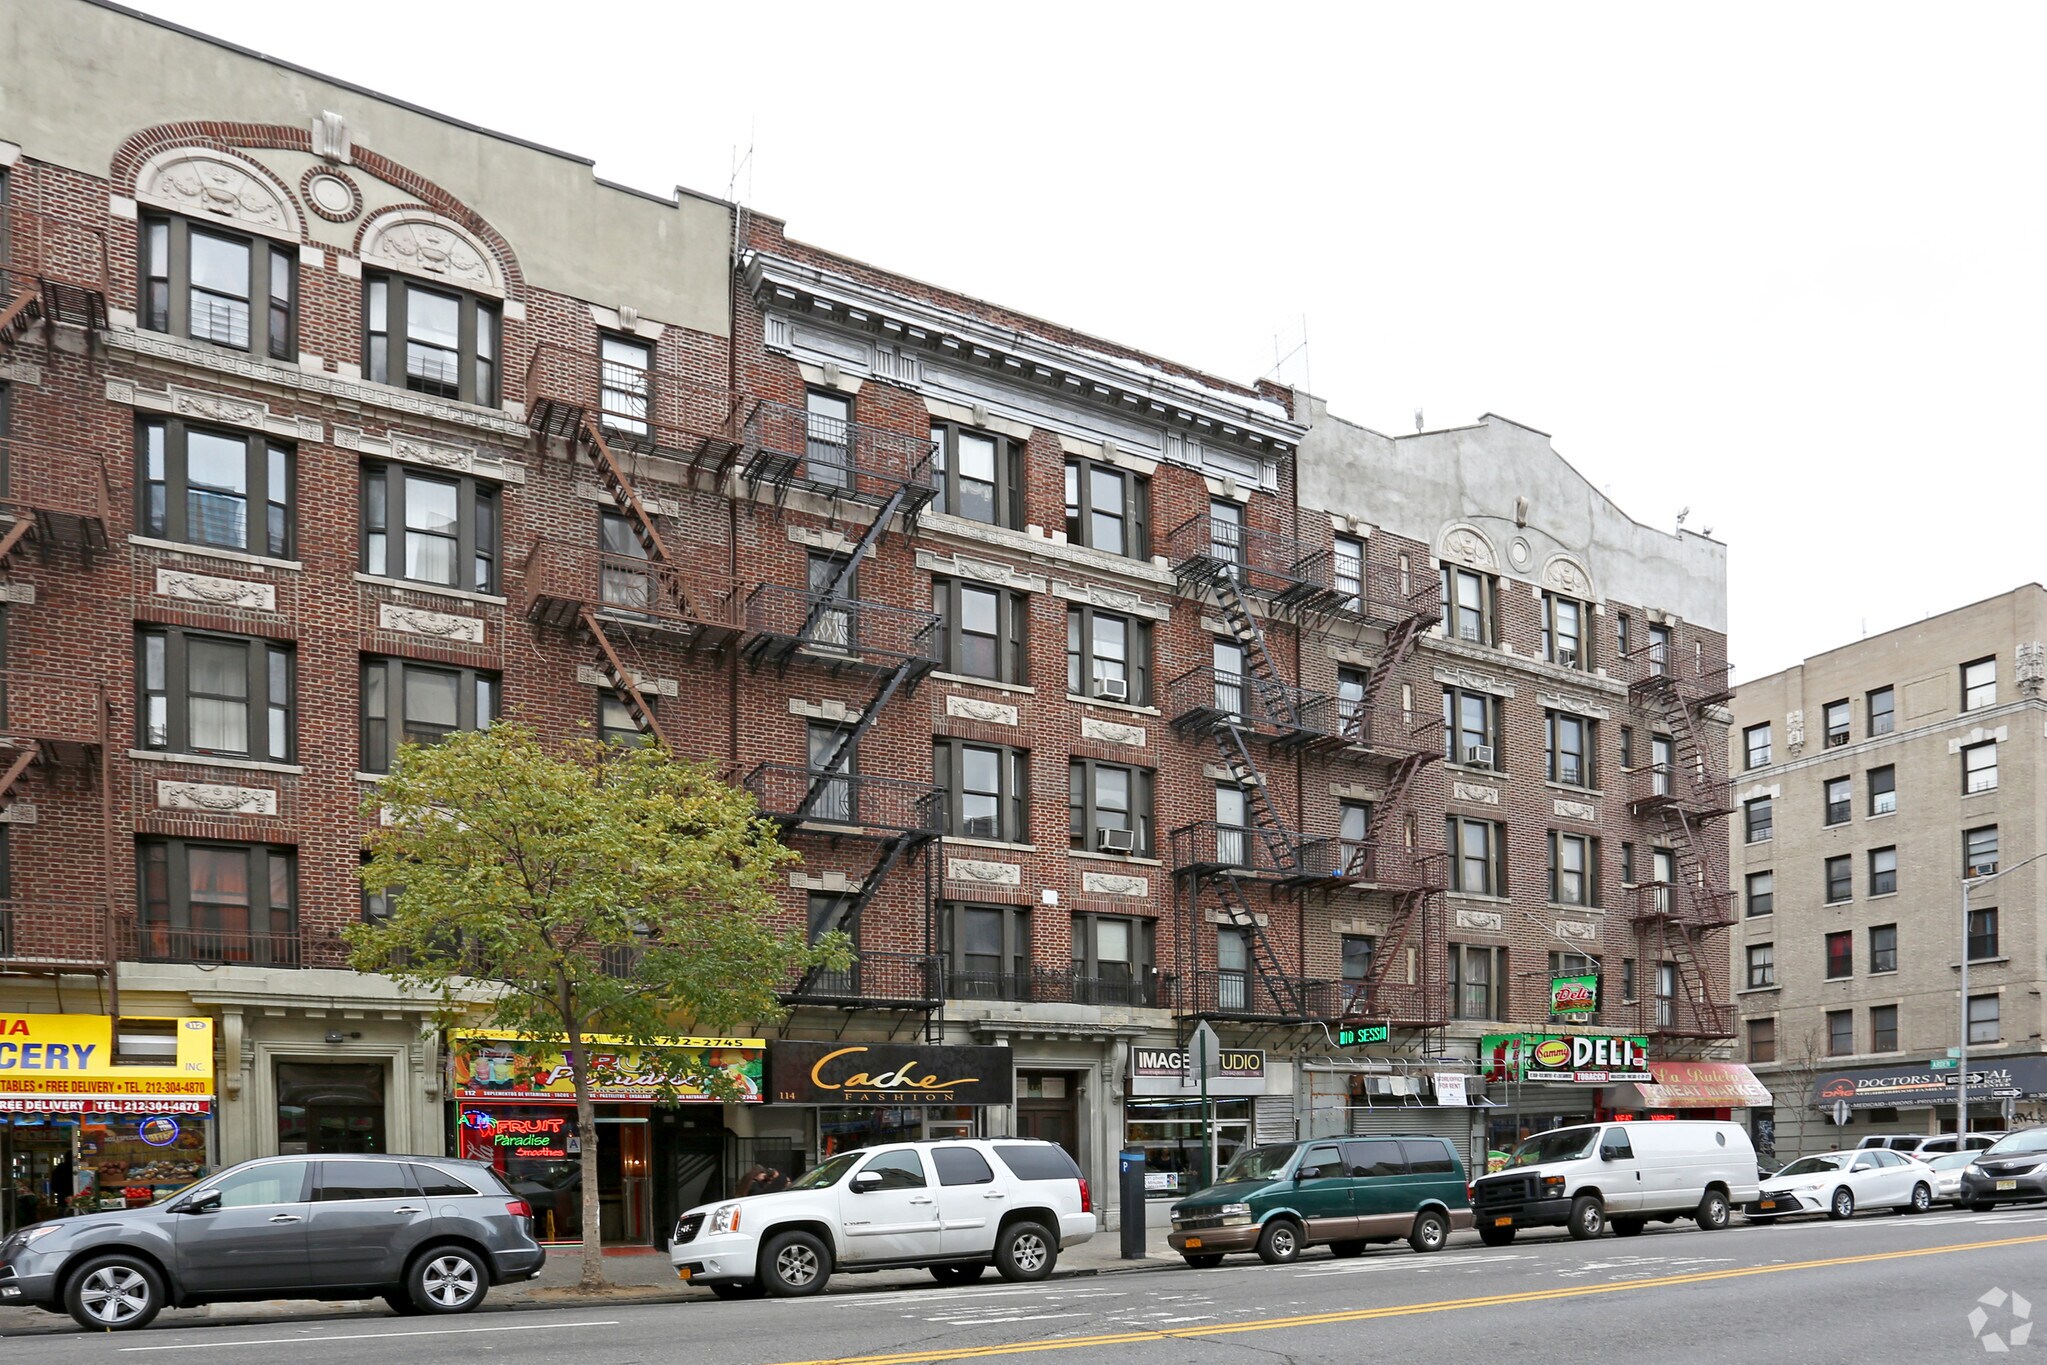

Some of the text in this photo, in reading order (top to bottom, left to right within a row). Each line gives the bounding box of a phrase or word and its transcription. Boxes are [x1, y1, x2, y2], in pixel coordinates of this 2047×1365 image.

[1557, 987, 1588, 1001] Deli
[188, 1022, 203, 1030] 112
[0, 1042, 96, 1069] CERY
[1573, 1036, 1630, 1067] DELI
[185, 1063, 205, 1071] INC.
[1139, 1052, 1260, 1070] IMAGE UDIO
[811, 1047, 980, 1089] Cache
[1577, 1072, 1607, 1081] TOBACCO
[1858, 1075, 1930, 1088] DOCTORS
[1, 1080, 205, 1093] TABLES FREE DELIVERY TEL. 212-304-4870
[1661, 1084, 1764, 1097] MEAT MARKET
[780, 1092, 795, 1100] 114
[845, 1093, 954, 1101] FASHION
[1822, 1090, 1854, 1098] DMG
[25, 1101, 85, 1110] DELIVERY
[96, 1101, 121, 1110] TEL.
[124, 1101, 199, 1111] 212-304-4870
[497, 1119, 564, 1134] FRUIT
[494, 1134, 551, 1147] Paradise
[569, 1139, 579, 1149] A
[515, 1147, 565, 1157] Smoothies
[1123, 1161, 1129, 1172] P
